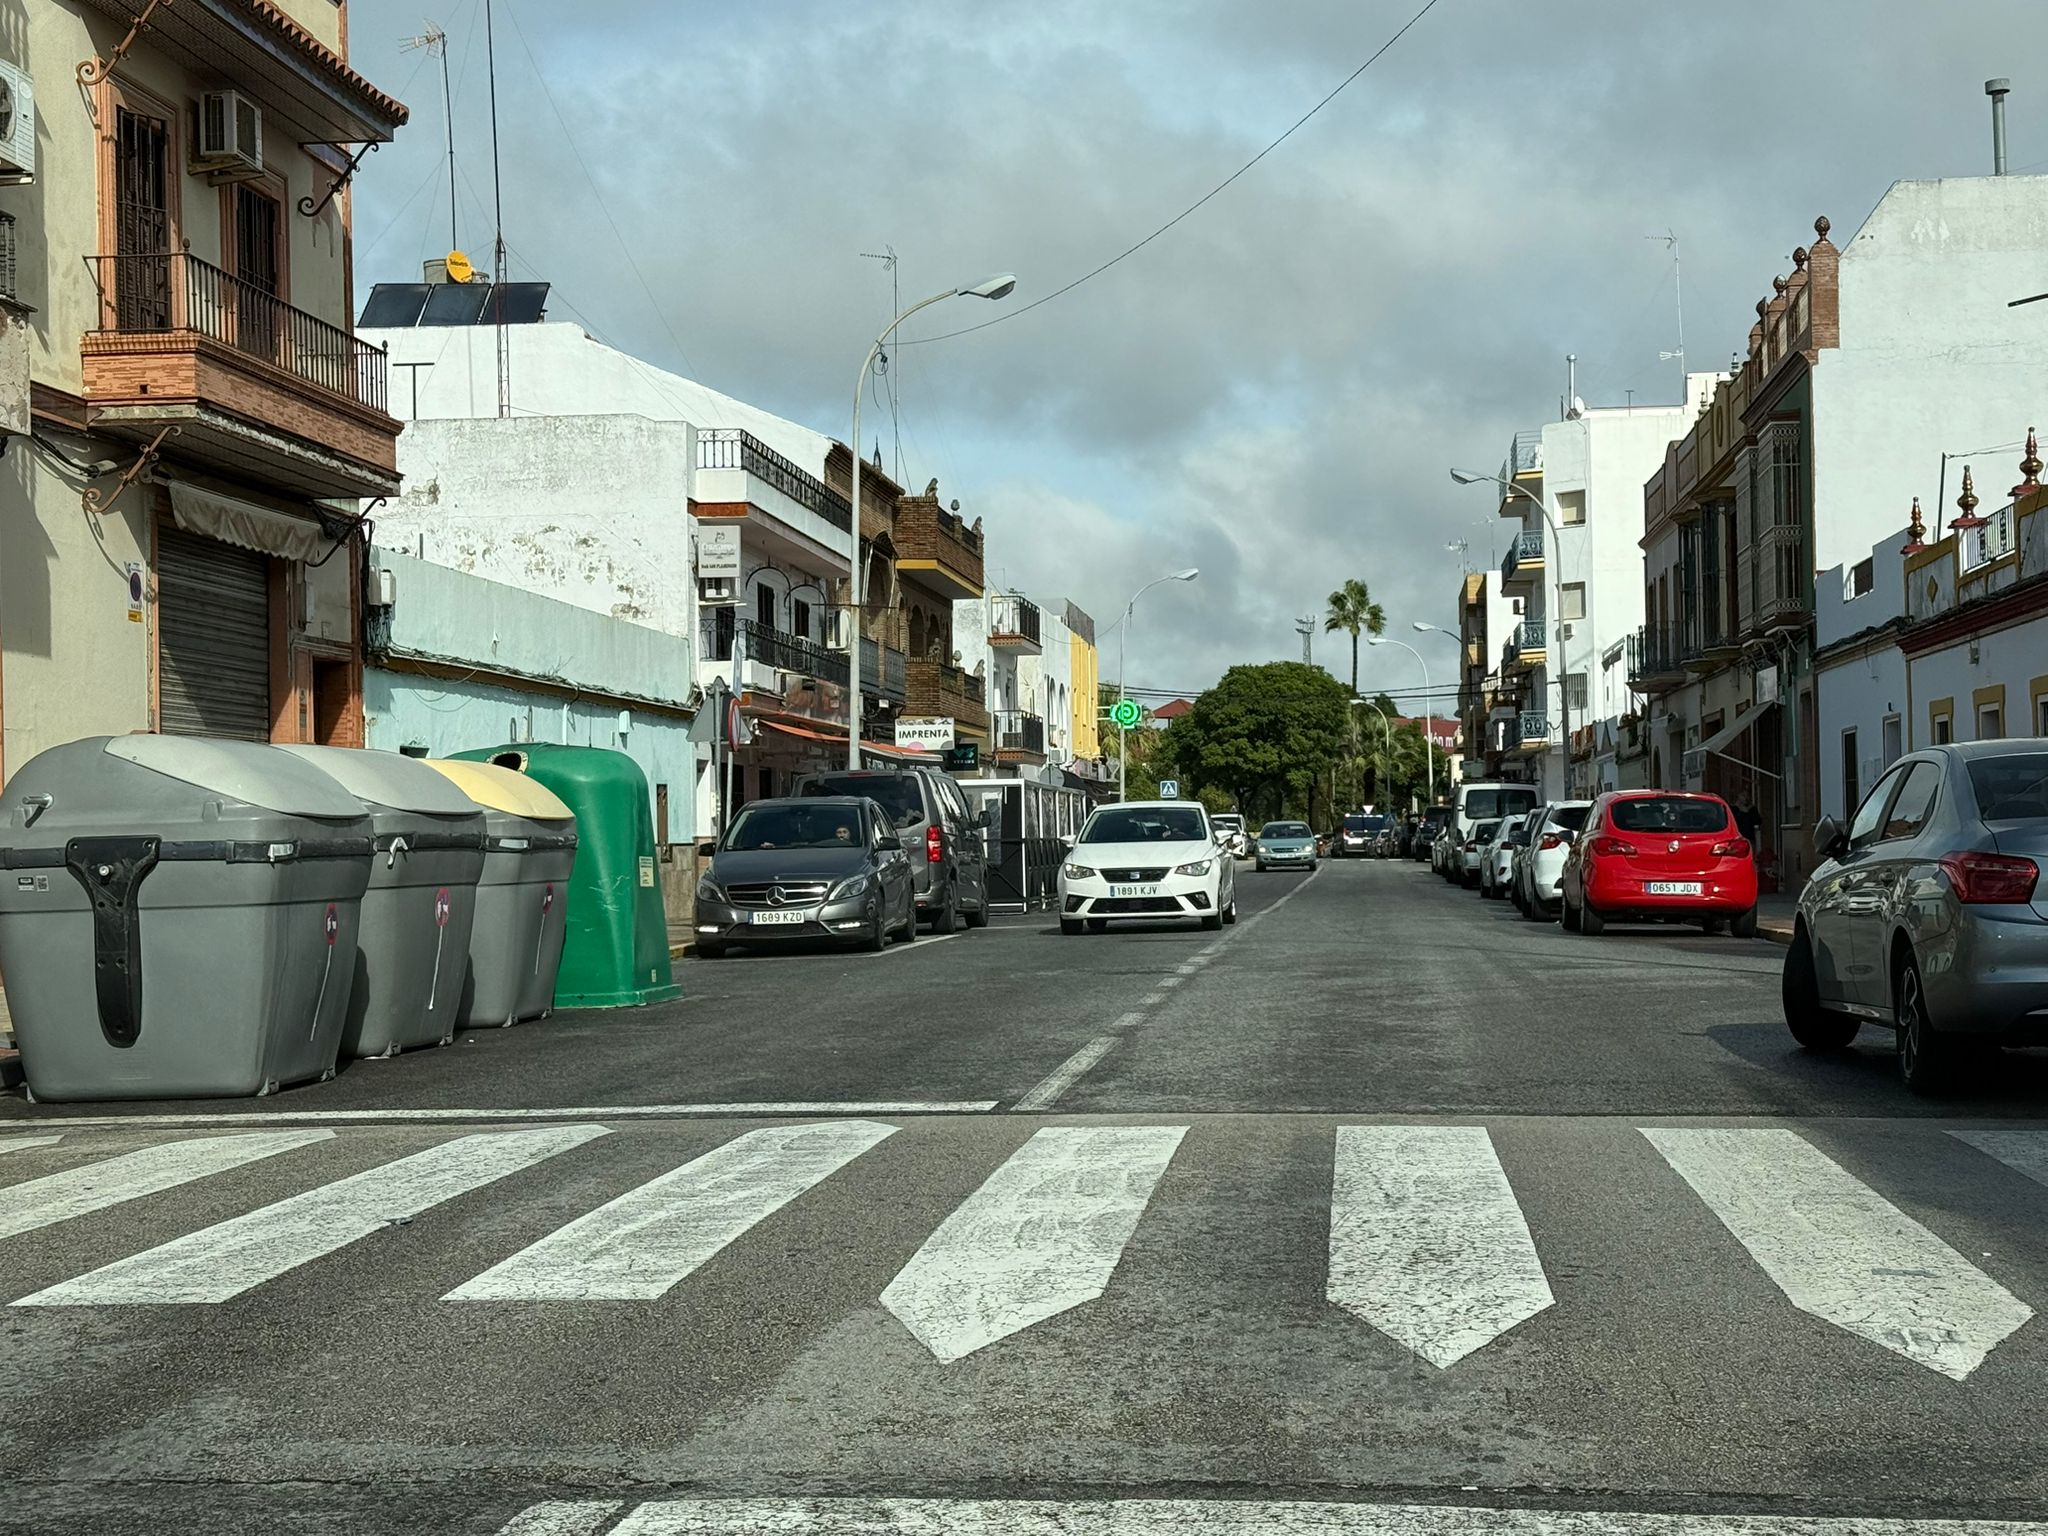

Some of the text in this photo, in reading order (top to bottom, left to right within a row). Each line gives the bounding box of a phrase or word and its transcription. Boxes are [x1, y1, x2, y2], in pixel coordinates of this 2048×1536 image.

[898, 729, 950, 739] IMPRENTA
[1117, 886, 1158, 896] 1891 KJV
[1652, 883, 1699, 893] 0651 JDX
[756, 912, 781, 923] 1689
